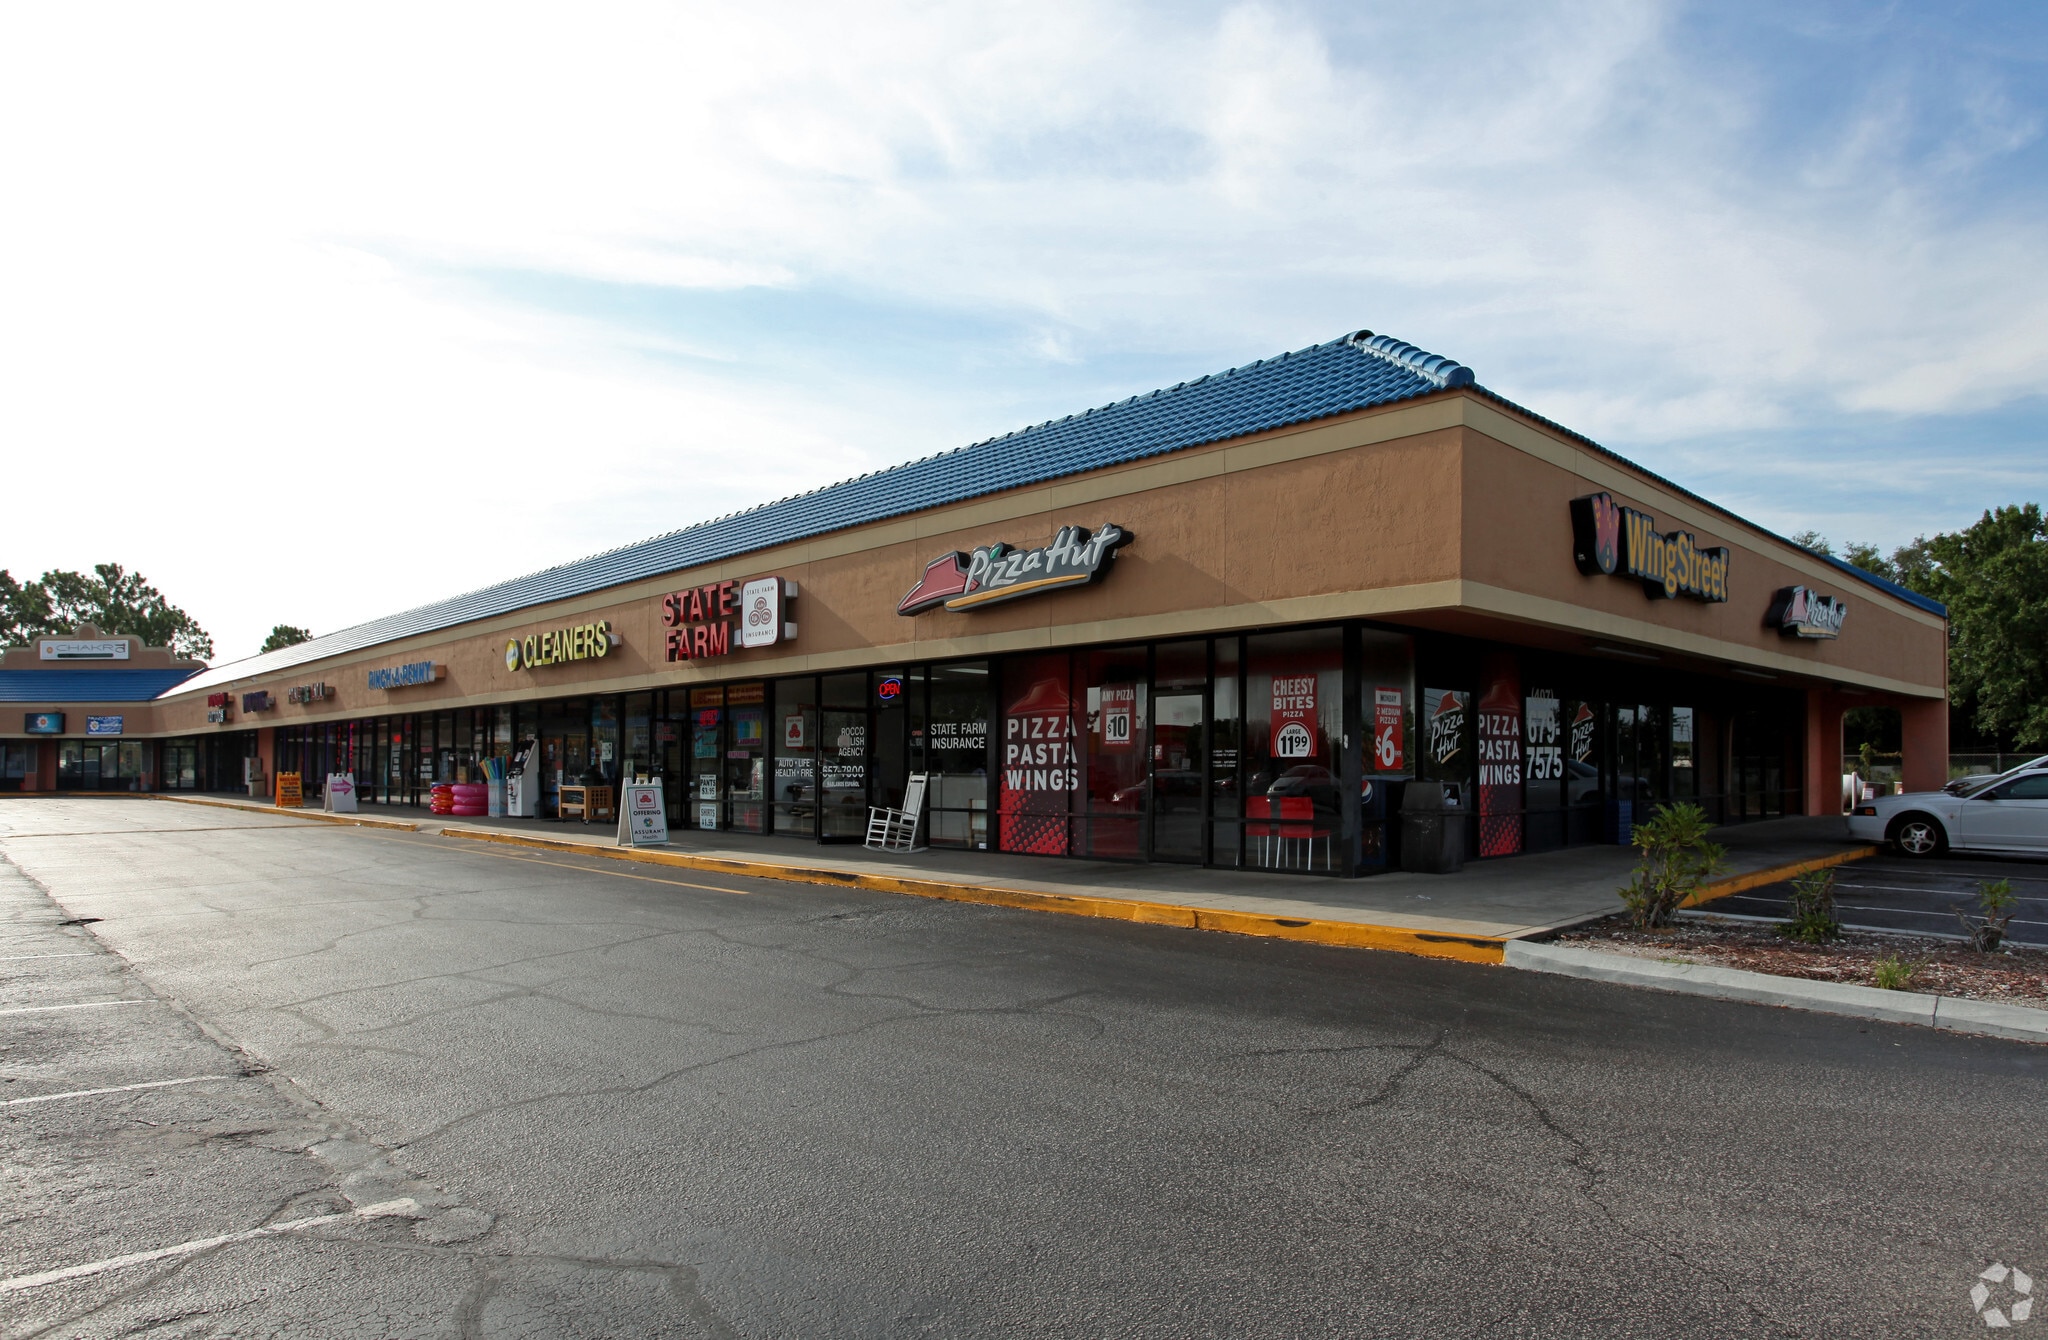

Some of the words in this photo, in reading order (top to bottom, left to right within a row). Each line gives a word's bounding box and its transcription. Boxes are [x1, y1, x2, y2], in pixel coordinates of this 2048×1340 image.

[964, 547, 1042, 595] Pizza
[1045, 527, 1118, 573] Hut
[1626, 512, 1727, 599] WingStreet
[661, 580, 734, 627] STATE
[1804, 589, 1828, 628] Pizza
[1827, 595, 1847, 630] Hut
[523, 619, 607, 669] CLEANERS
[665, 621, 729, 662] FARM
[879, 683, 900, 695] OPEN
[1101, 690, 1115, 702] ANY
[1116, 689, 1134, 702] PIZZA
[1273, 678, 1315, 696] CHEESY
[1273, 695, 1315, 710] BITES
[1376, 707, 1381, 715] 2
[841, 726, 864, 736] ROCCO
[930, 723, 957, 735] STATE
[961, 722, 987, 735] FARM
[1007, 715, 1078, 740] PIZZA
[1107, 715, 1128, 738] $10
[1380, 716, 1398, 725] PIZZAS
[1479, 714, 1520, 736] PIZZA
[931, 737, 985, 749] INSURANCE
[1430, 714, 1465, 753] Pizza
[1571, 722, 1595, 755] Pizza
[838, 747, 864, 757] AGENCY
[1007, 742, 1078, 765] PASTA
[1375, 725, 1395, 767] $6
[1437, 731, 1462, 761] Hut
[1479, 740, 1520, 760] PASTA
[1576, 736, 1592, 761] Hut
[775, 769, 796, 777] HEALTH
[800, 769, 814, 777] FIRE
[778, 759, 794, 768] AUTO
[798, 759, 811, 768] LIFE
[822, 765, 864, 778] 657-7800
[1526, 746, 1563, 779] 7575
[700, 779, 716, 787] PANTS
[1006, 769, 1079, 791] WINGS
[1479, 765, 1520, 785] WINGS
